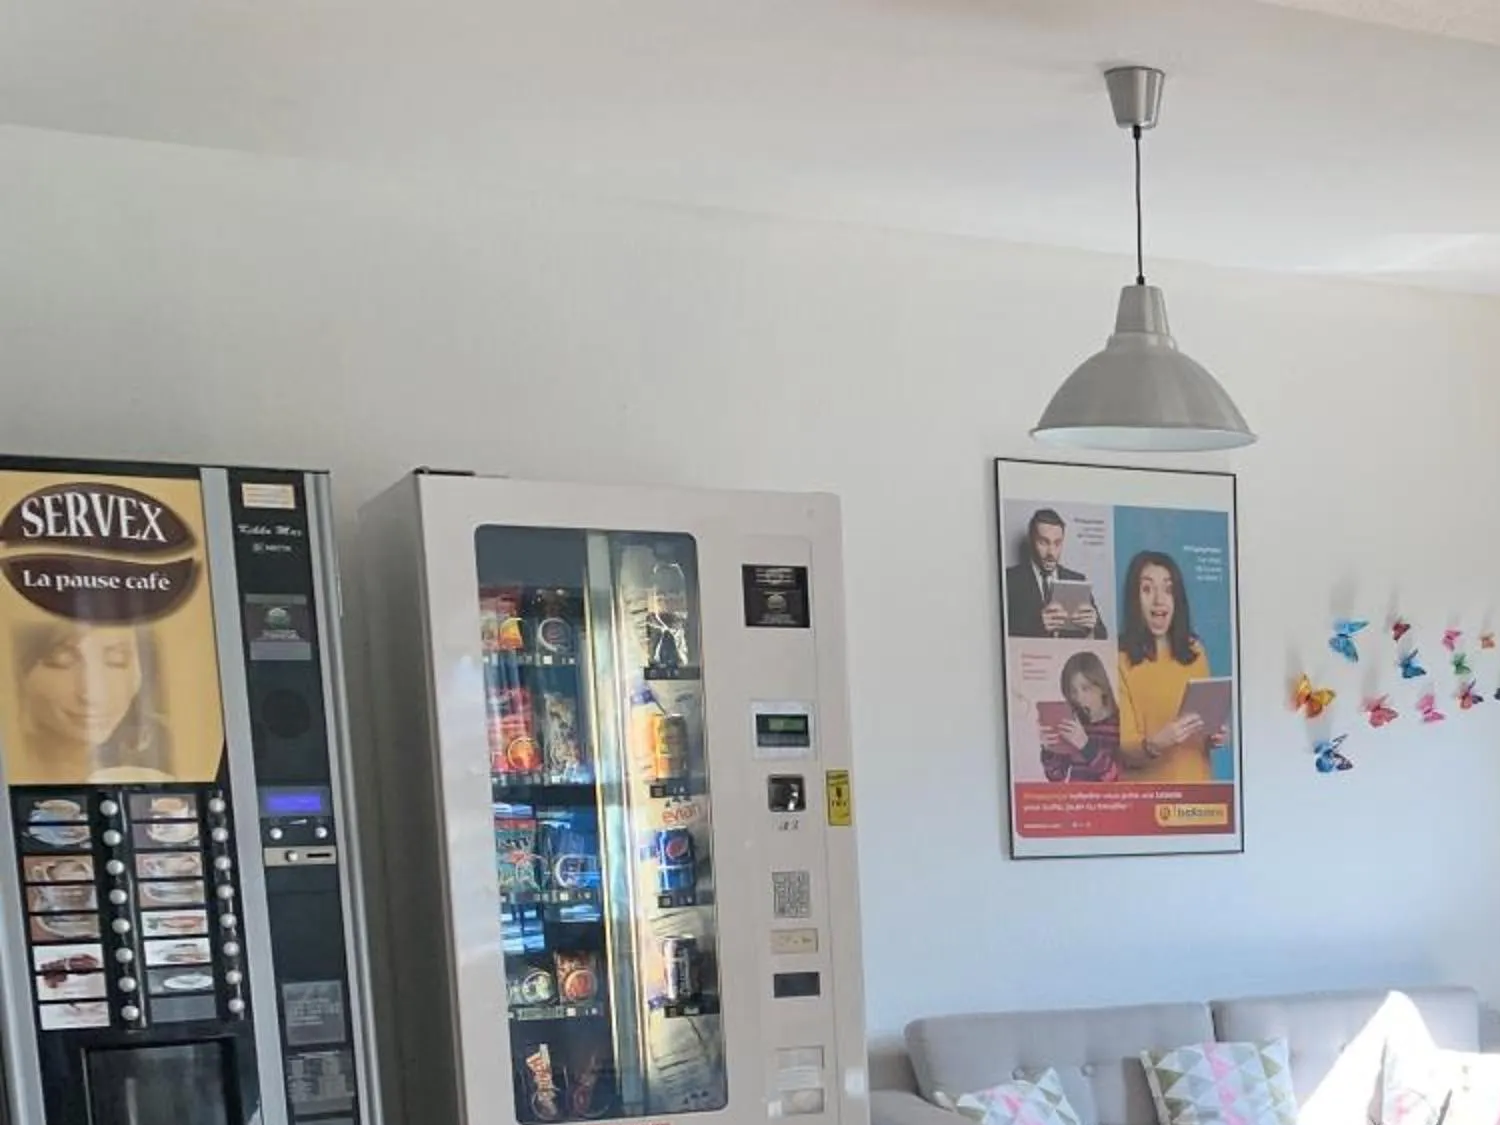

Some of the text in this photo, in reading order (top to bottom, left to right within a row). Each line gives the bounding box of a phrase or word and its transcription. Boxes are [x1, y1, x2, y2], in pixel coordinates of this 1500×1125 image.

[21, 492, 168, 543] SERVEX
[23, 569, 50, 587] La
[55, 574, 121, 592] pause
